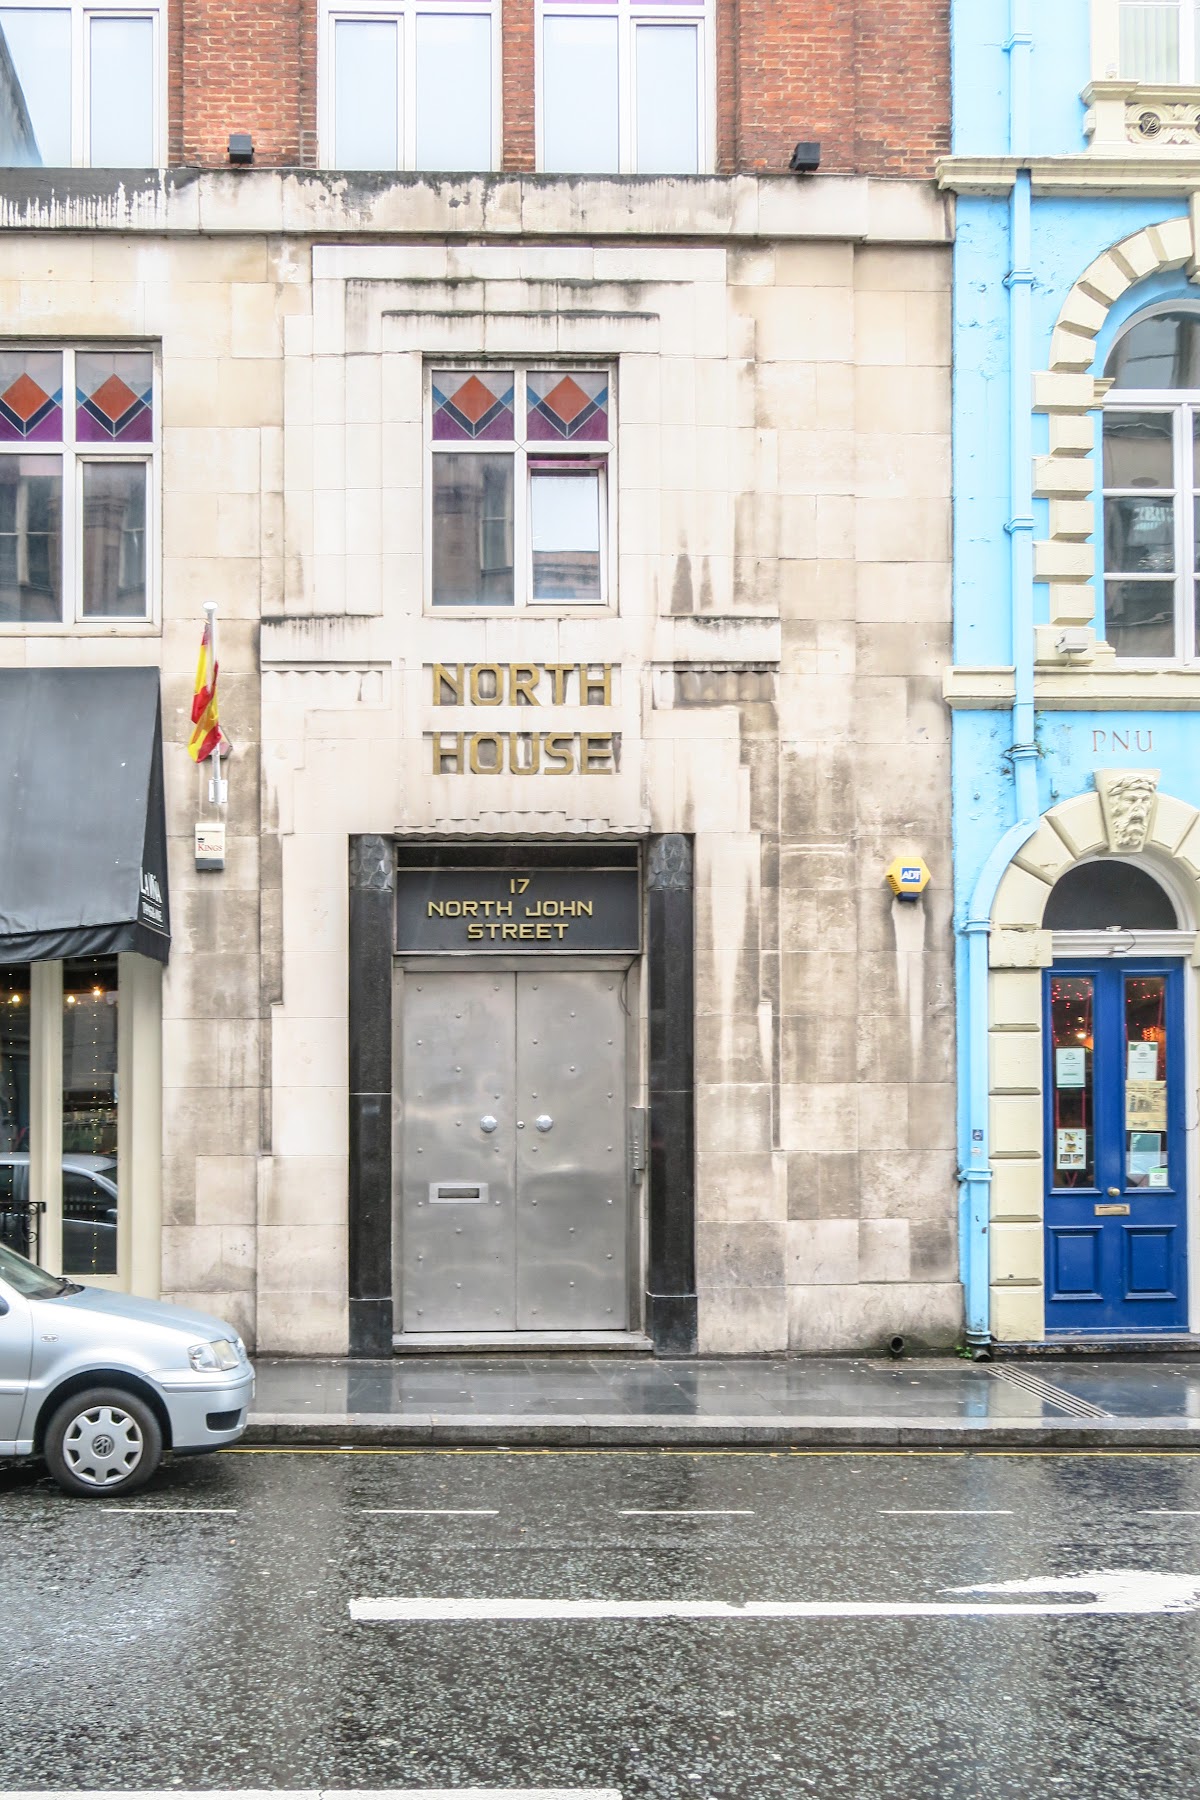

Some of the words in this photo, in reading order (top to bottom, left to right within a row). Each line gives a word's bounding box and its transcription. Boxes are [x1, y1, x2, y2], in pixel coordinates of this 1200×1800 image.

[432, 663, 612, 706] NORTH
[1091, 729, 1152, 752] PNU
[432, 732, 612, 775] HOUSE
[901, 870, 921, 880] ADT
[510, 878, 530, 894] 17
[427, 900, 513, 917] NORTH
[525, 900, 594, 917] JOHN
[467, 923, 570, 939] STREET
